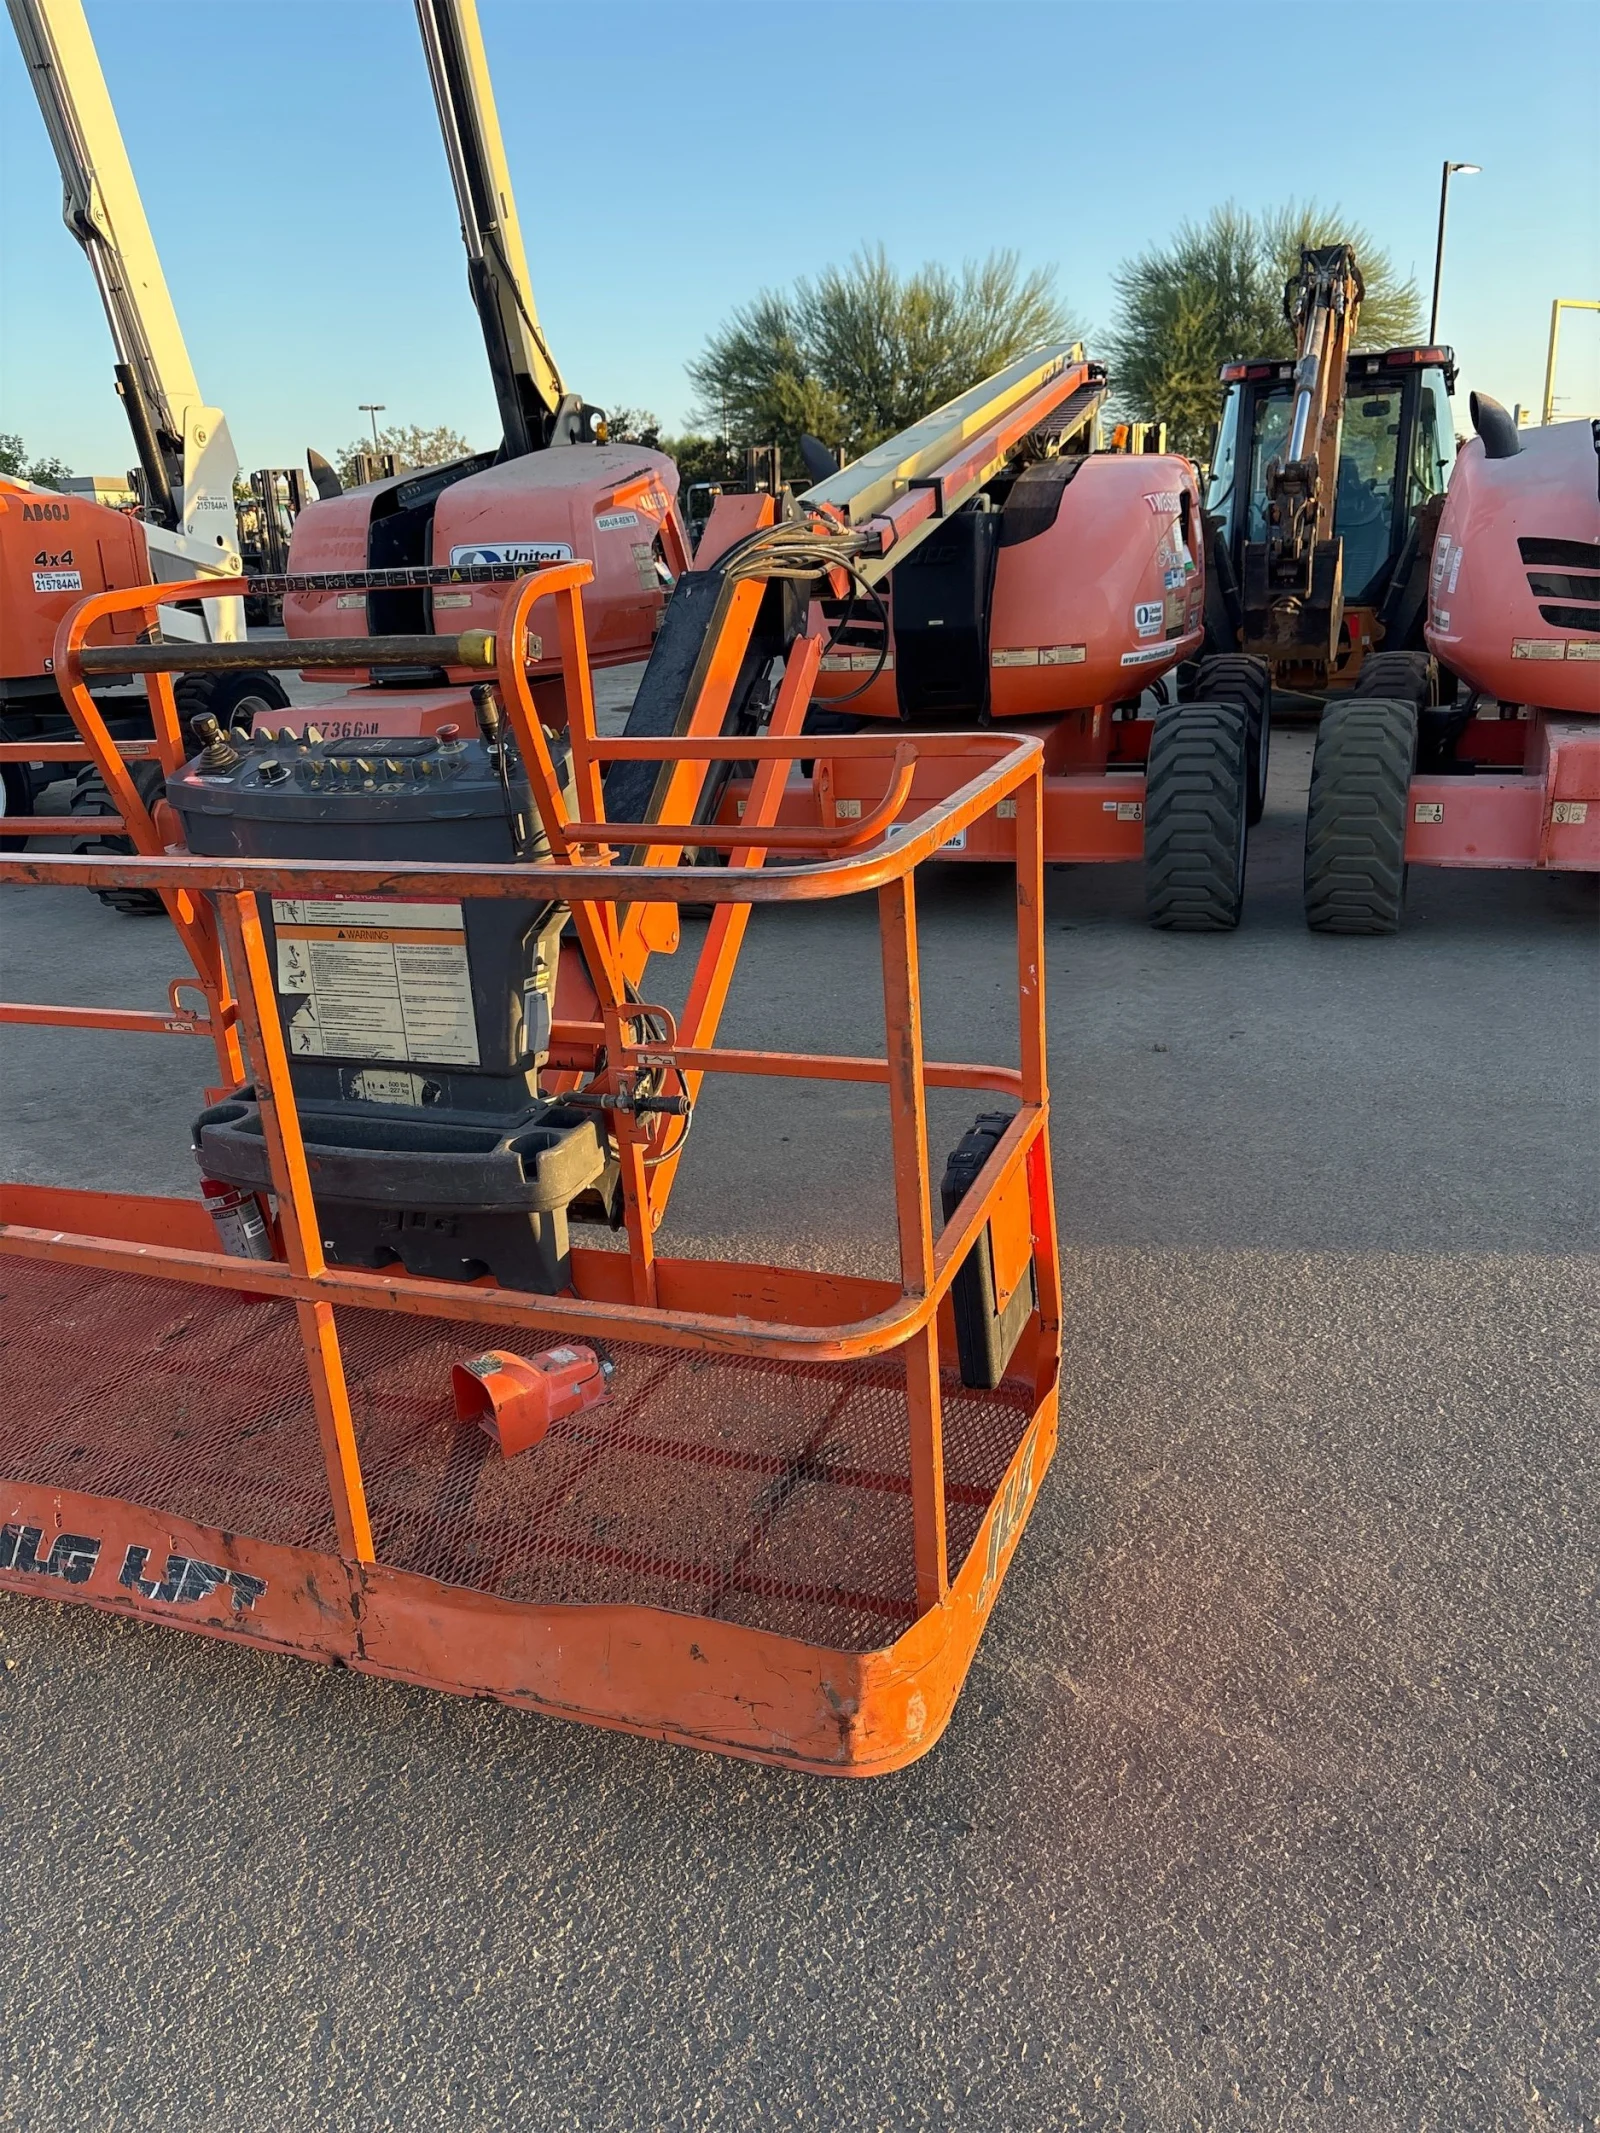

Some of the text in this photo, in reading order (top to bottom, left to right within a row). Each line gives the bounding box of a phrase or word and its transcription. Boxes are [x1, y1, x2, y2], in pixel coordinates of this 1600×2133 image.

[34, 550, 73, 567] 4x4
[504, 549, 561, 562] United
[35, 578, 80, 591] 215784AH
[346, 930, 389, 941] WARNING
